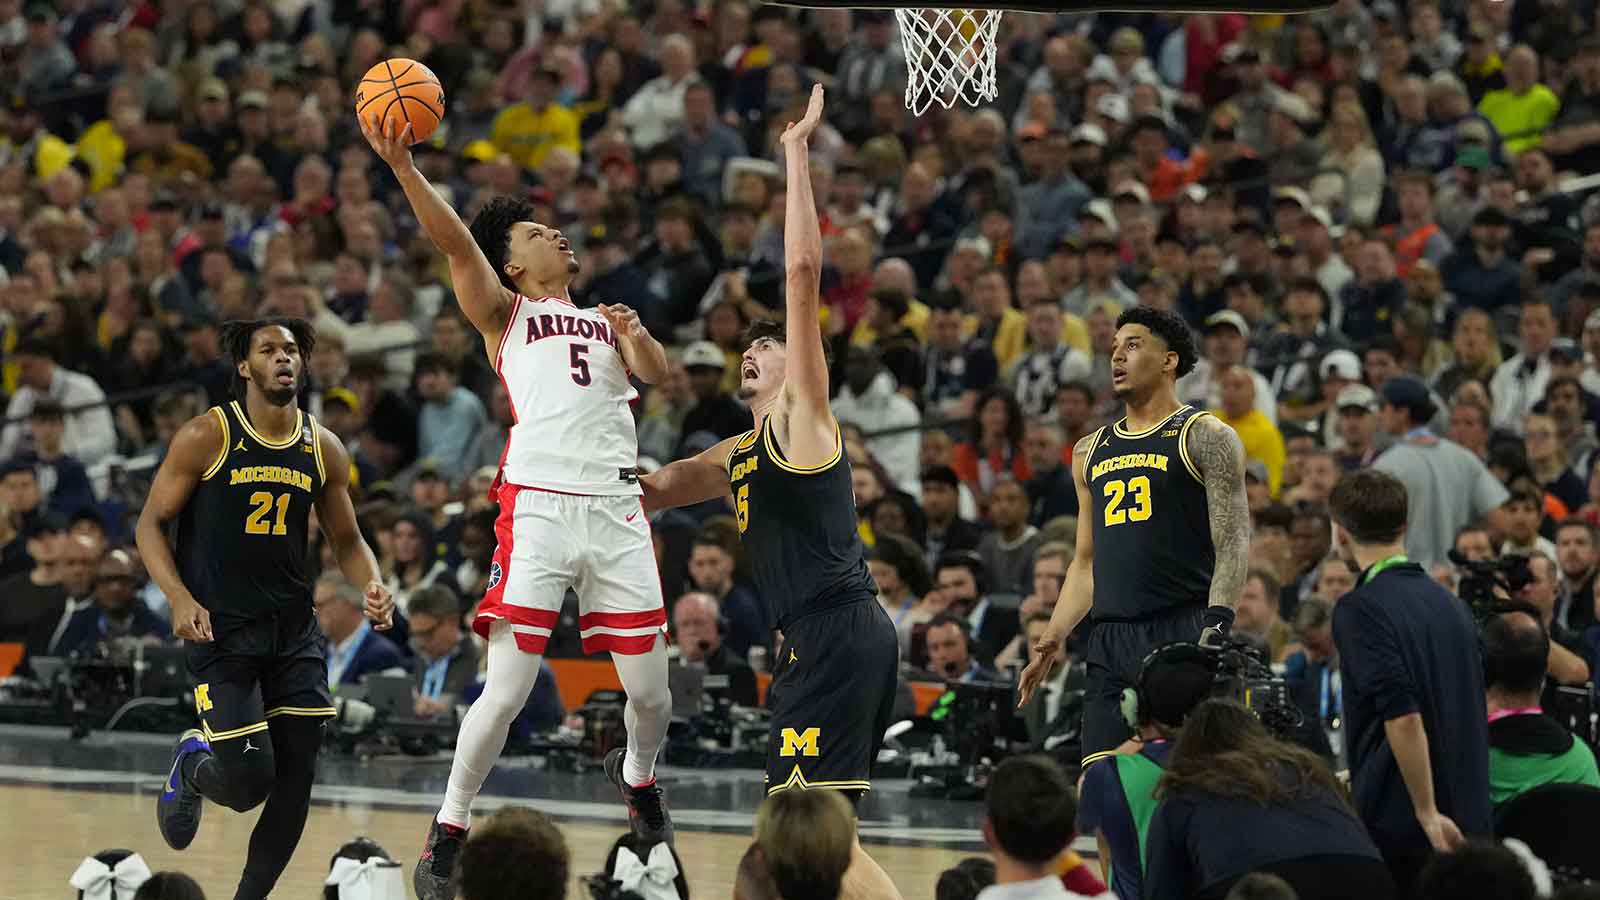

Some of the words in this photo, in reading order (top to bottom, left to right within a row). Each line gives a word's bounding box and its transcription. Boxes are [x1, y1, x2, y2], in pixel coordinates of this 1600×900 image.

[569, 342, 592, 388] 5
[229, 465, 312, 492] MICHIGAN
[1091, 453, 1169, 482] MICHIGAN
[245, 491, 291, 535] 21
[1103, 475, 1153, 527] 23
[780, 727, 820, 757] M
